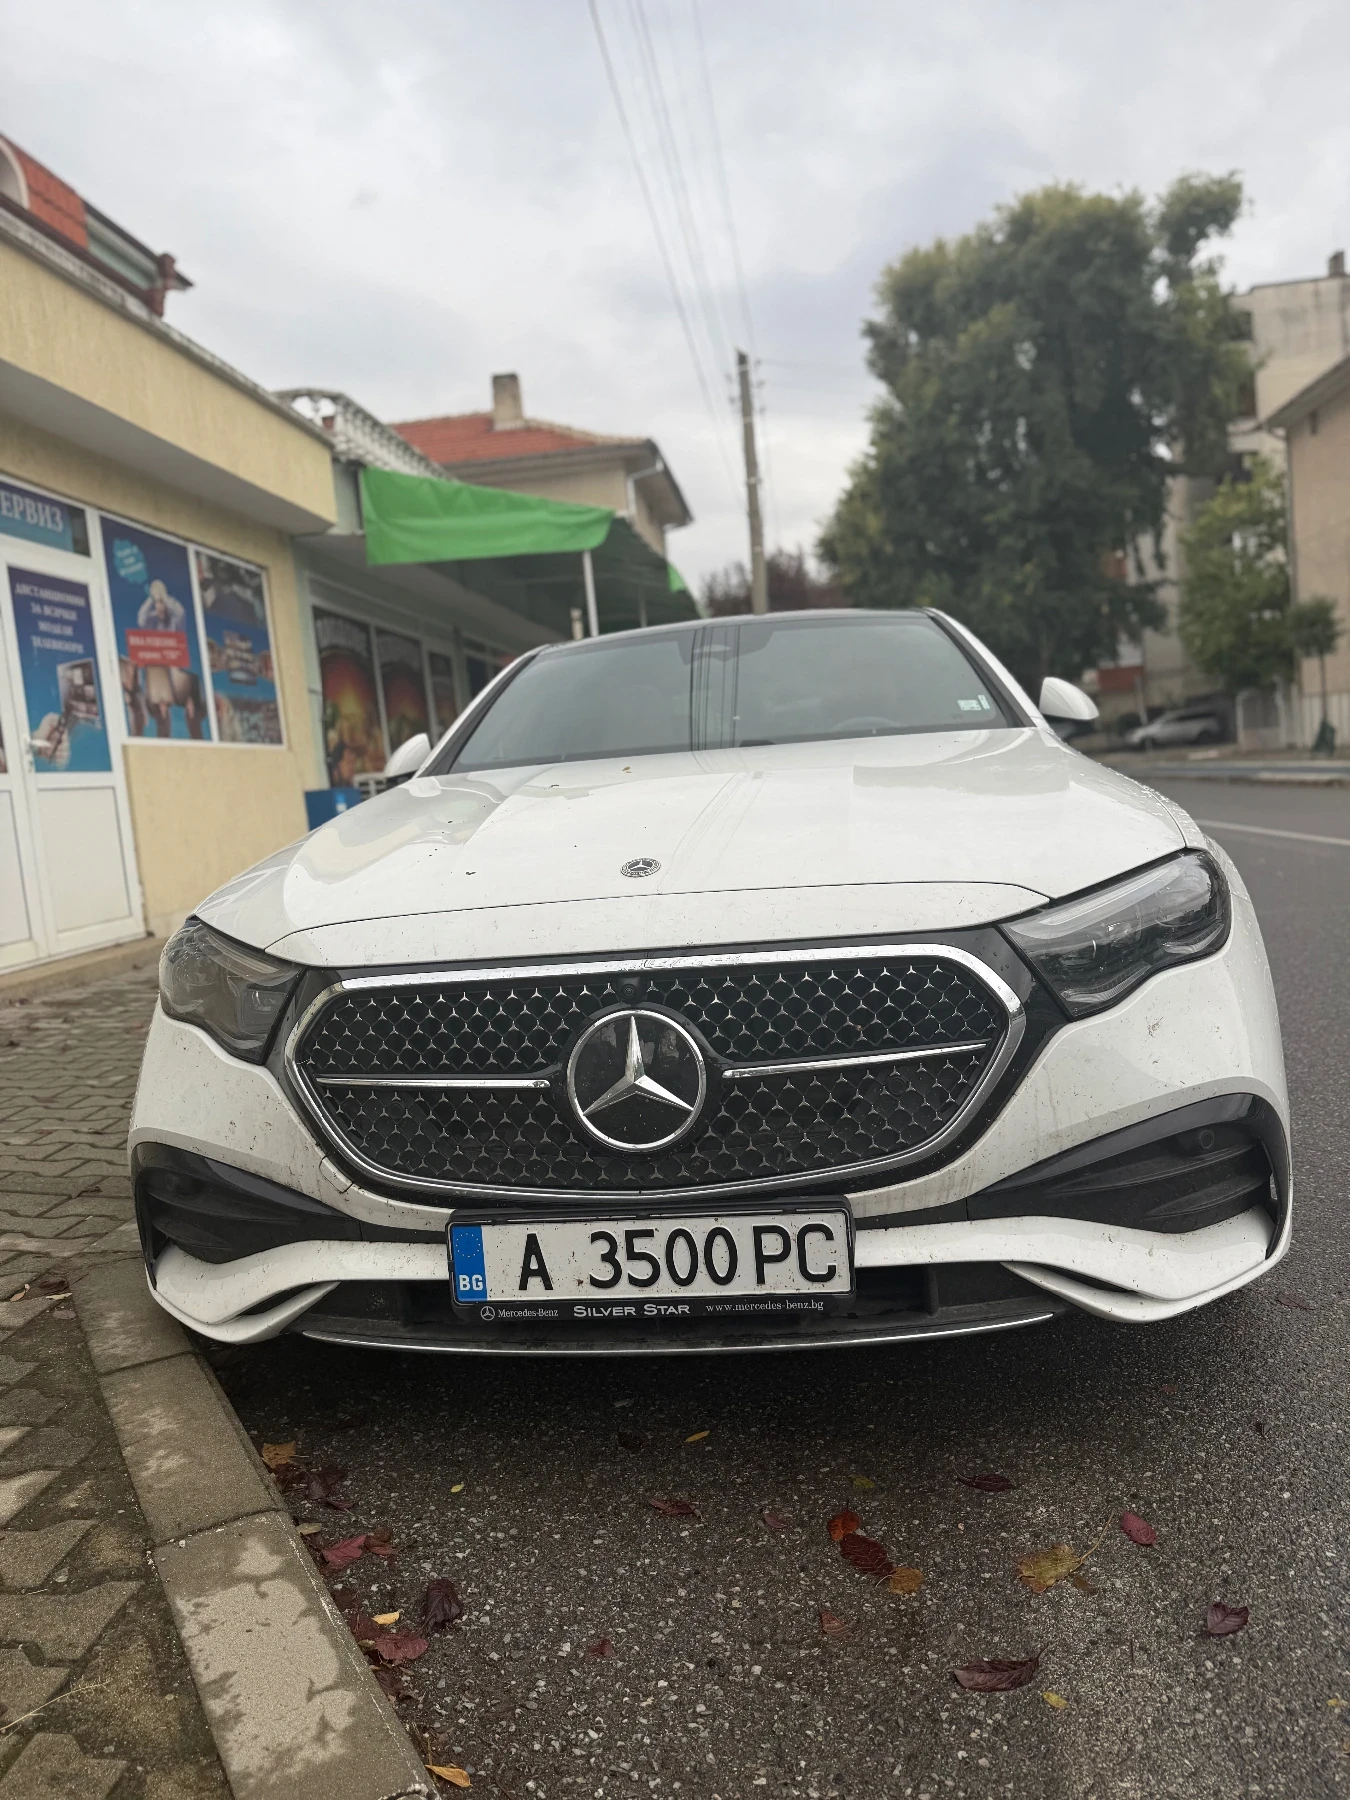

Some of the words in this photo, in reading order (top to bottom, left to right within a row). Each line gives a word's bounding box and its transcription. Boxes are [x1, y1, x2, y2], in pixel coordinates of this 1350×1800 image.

[518, 1232, 554, 1291] A
[589, 1226, 738, 1289] 3500
[752, 1223, 837, 1285] PC
[458, 1274, 484, 1291] BG
[497, 1308, 559, 1318] Mercedes-Benz
[705, 1299, 824, 1312] www.mercedes-benz.bg
